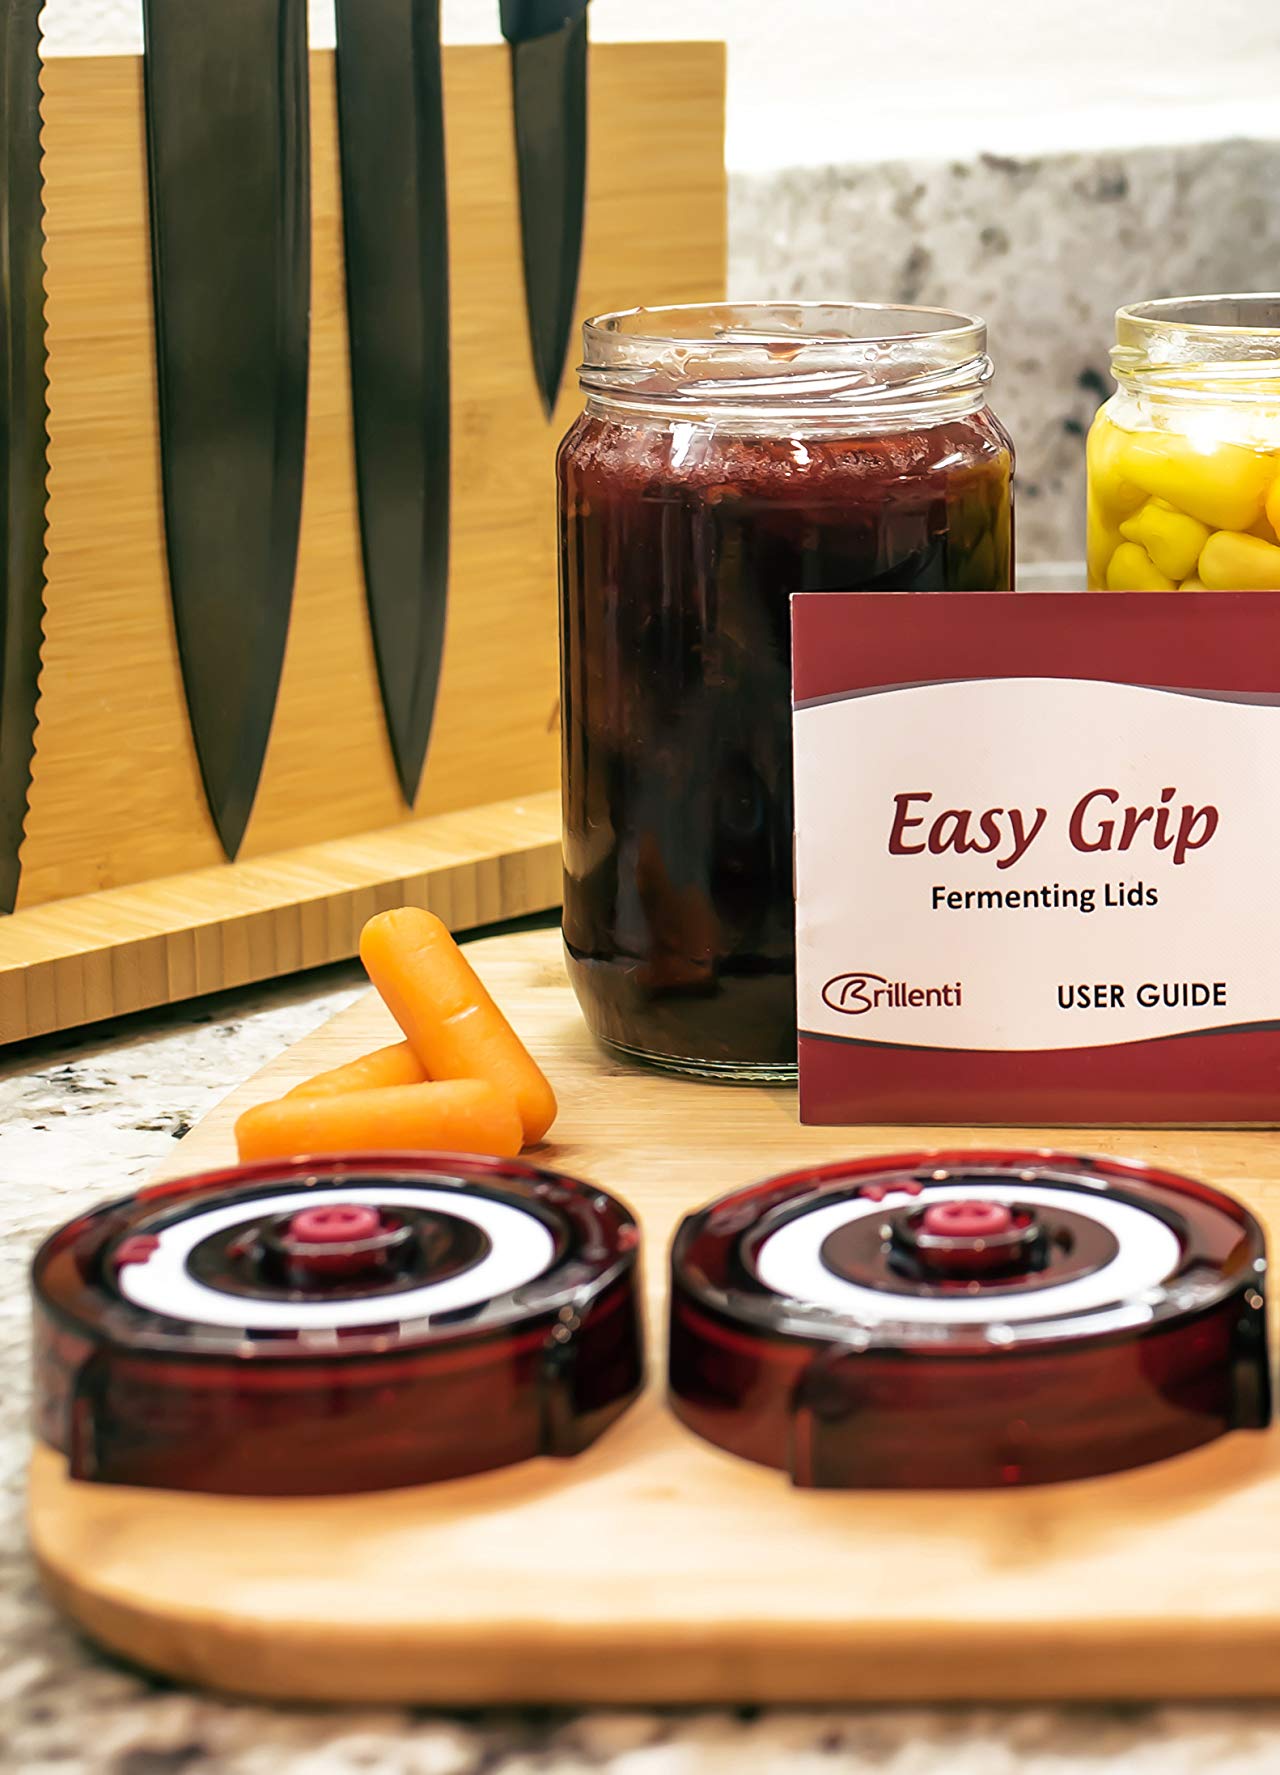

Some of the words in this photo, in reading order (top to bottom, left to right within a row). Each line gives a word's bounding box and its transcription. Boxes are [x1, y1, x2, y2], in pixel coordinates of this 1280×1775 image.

[888, 791, 1047, 870] Easy
[1068, 787, 1219, 865] Grip
[931, 883, 1096, 913] Fermenting
[1104, 881, 1159, 908] Lids
[821, 972, 962, 1015] Brillenti
[1057, 984, 1126, 1009] USER
[1136, 982, 1228, 1007] GUIDE
